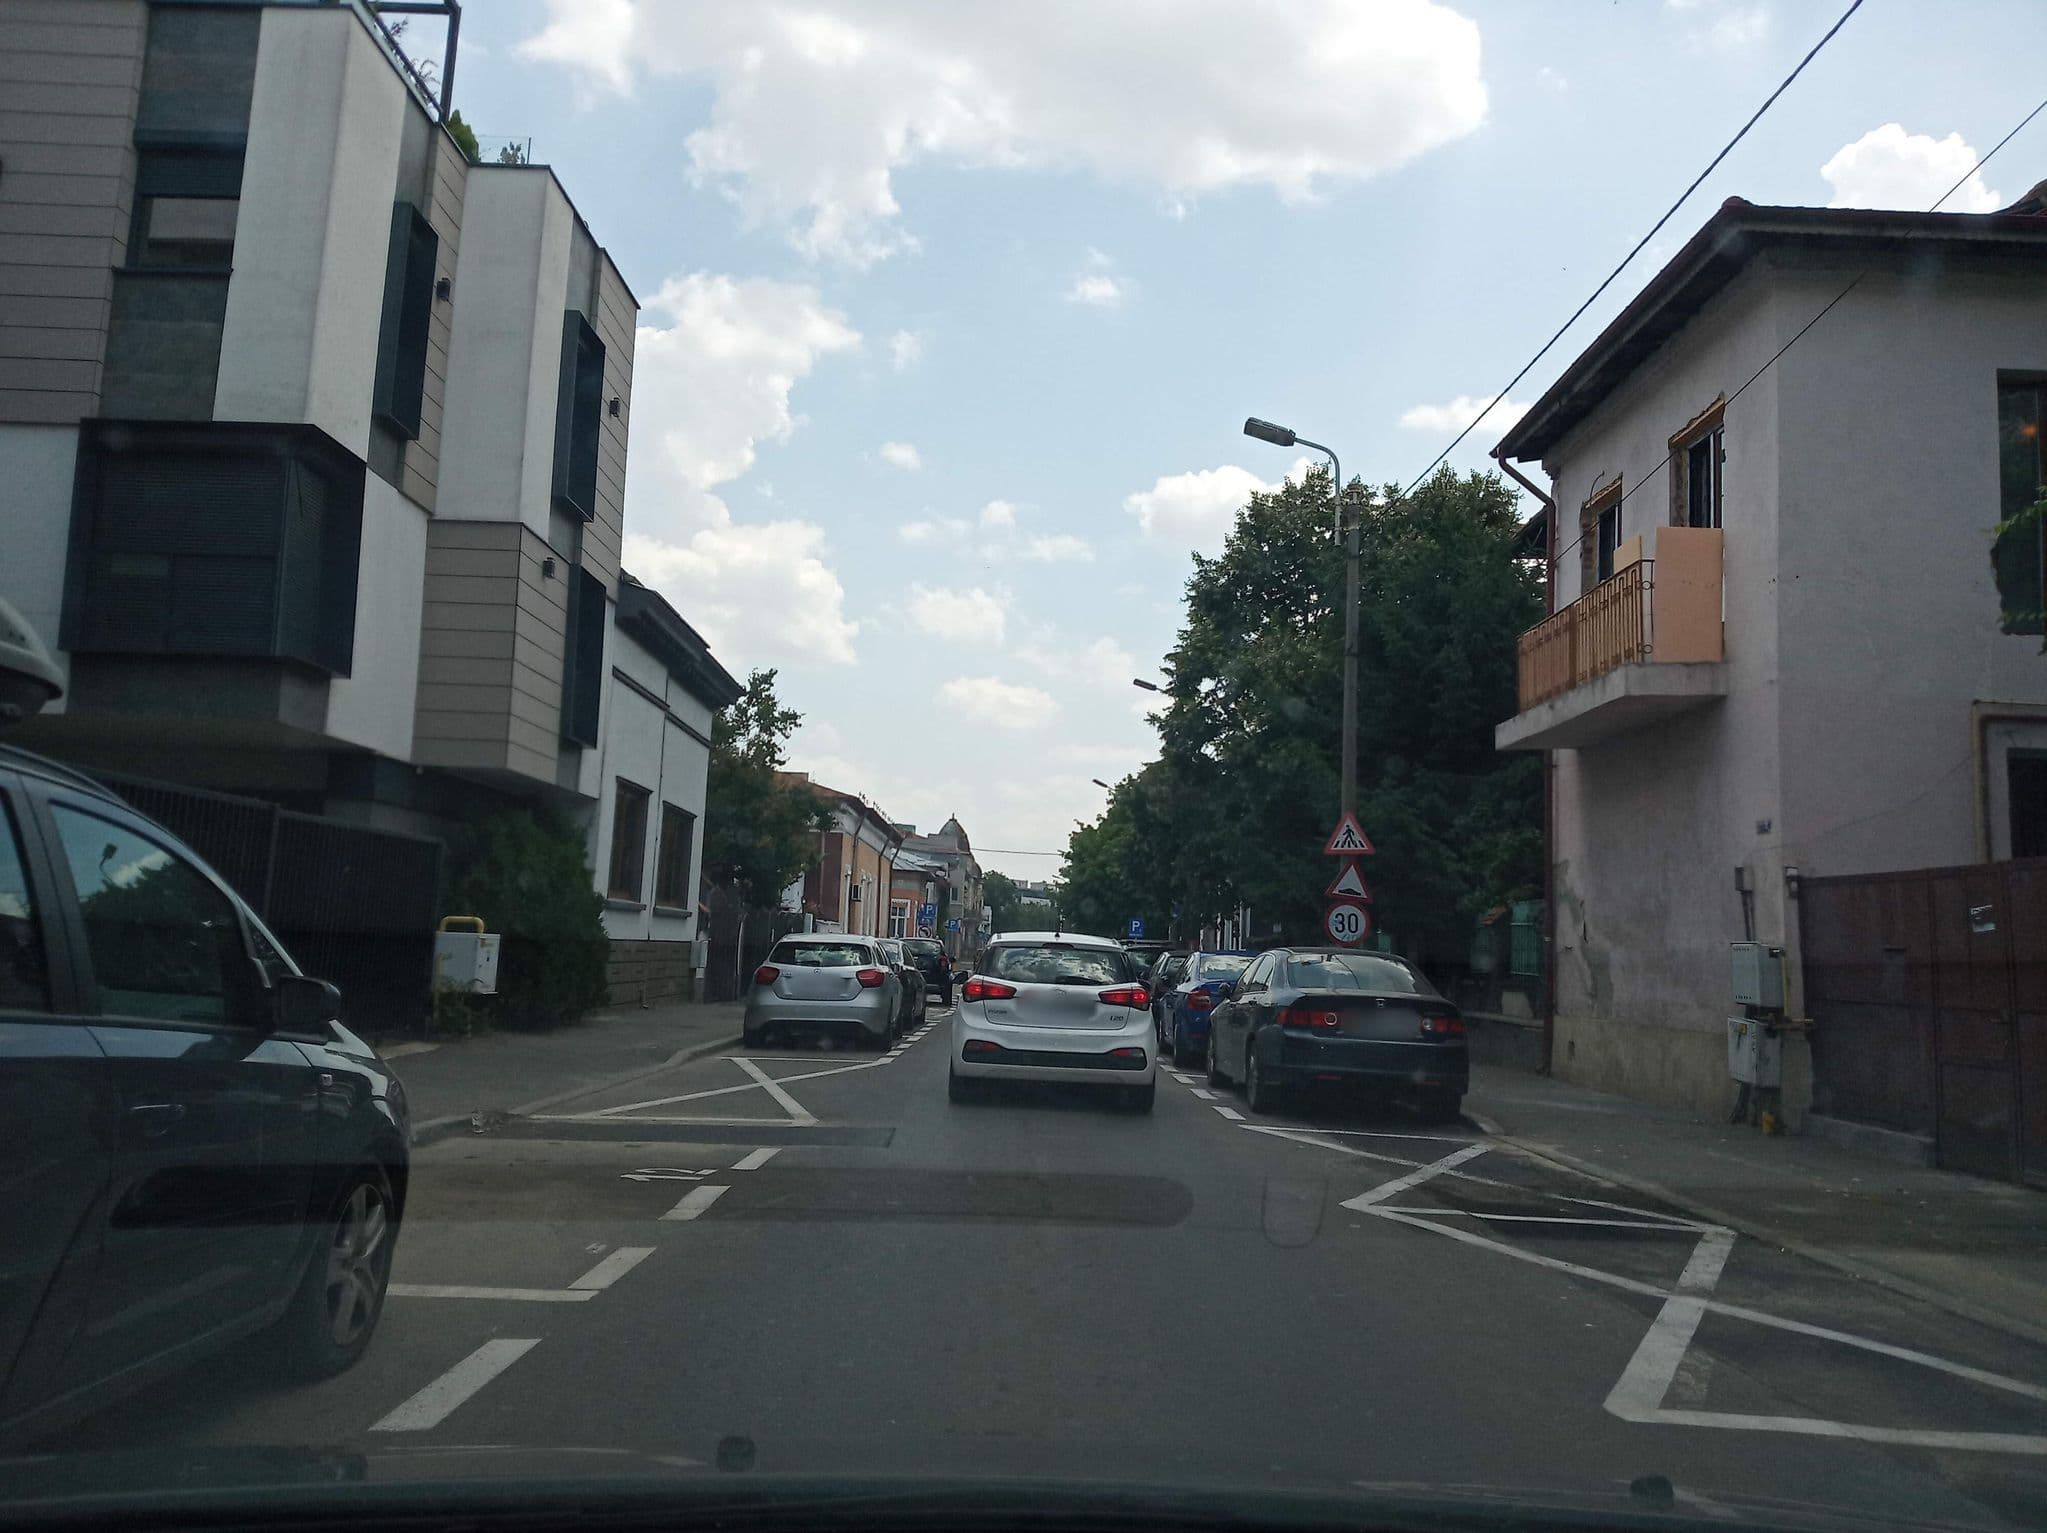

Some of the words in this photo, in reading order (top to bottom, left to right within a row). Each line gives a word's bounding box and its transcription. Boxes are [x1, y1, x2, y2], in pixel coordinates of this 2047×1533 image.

[926, 905, 933, 914] P
[1132, 921, 1140, 931] P
[1335, 913, 1358, 933] 30
